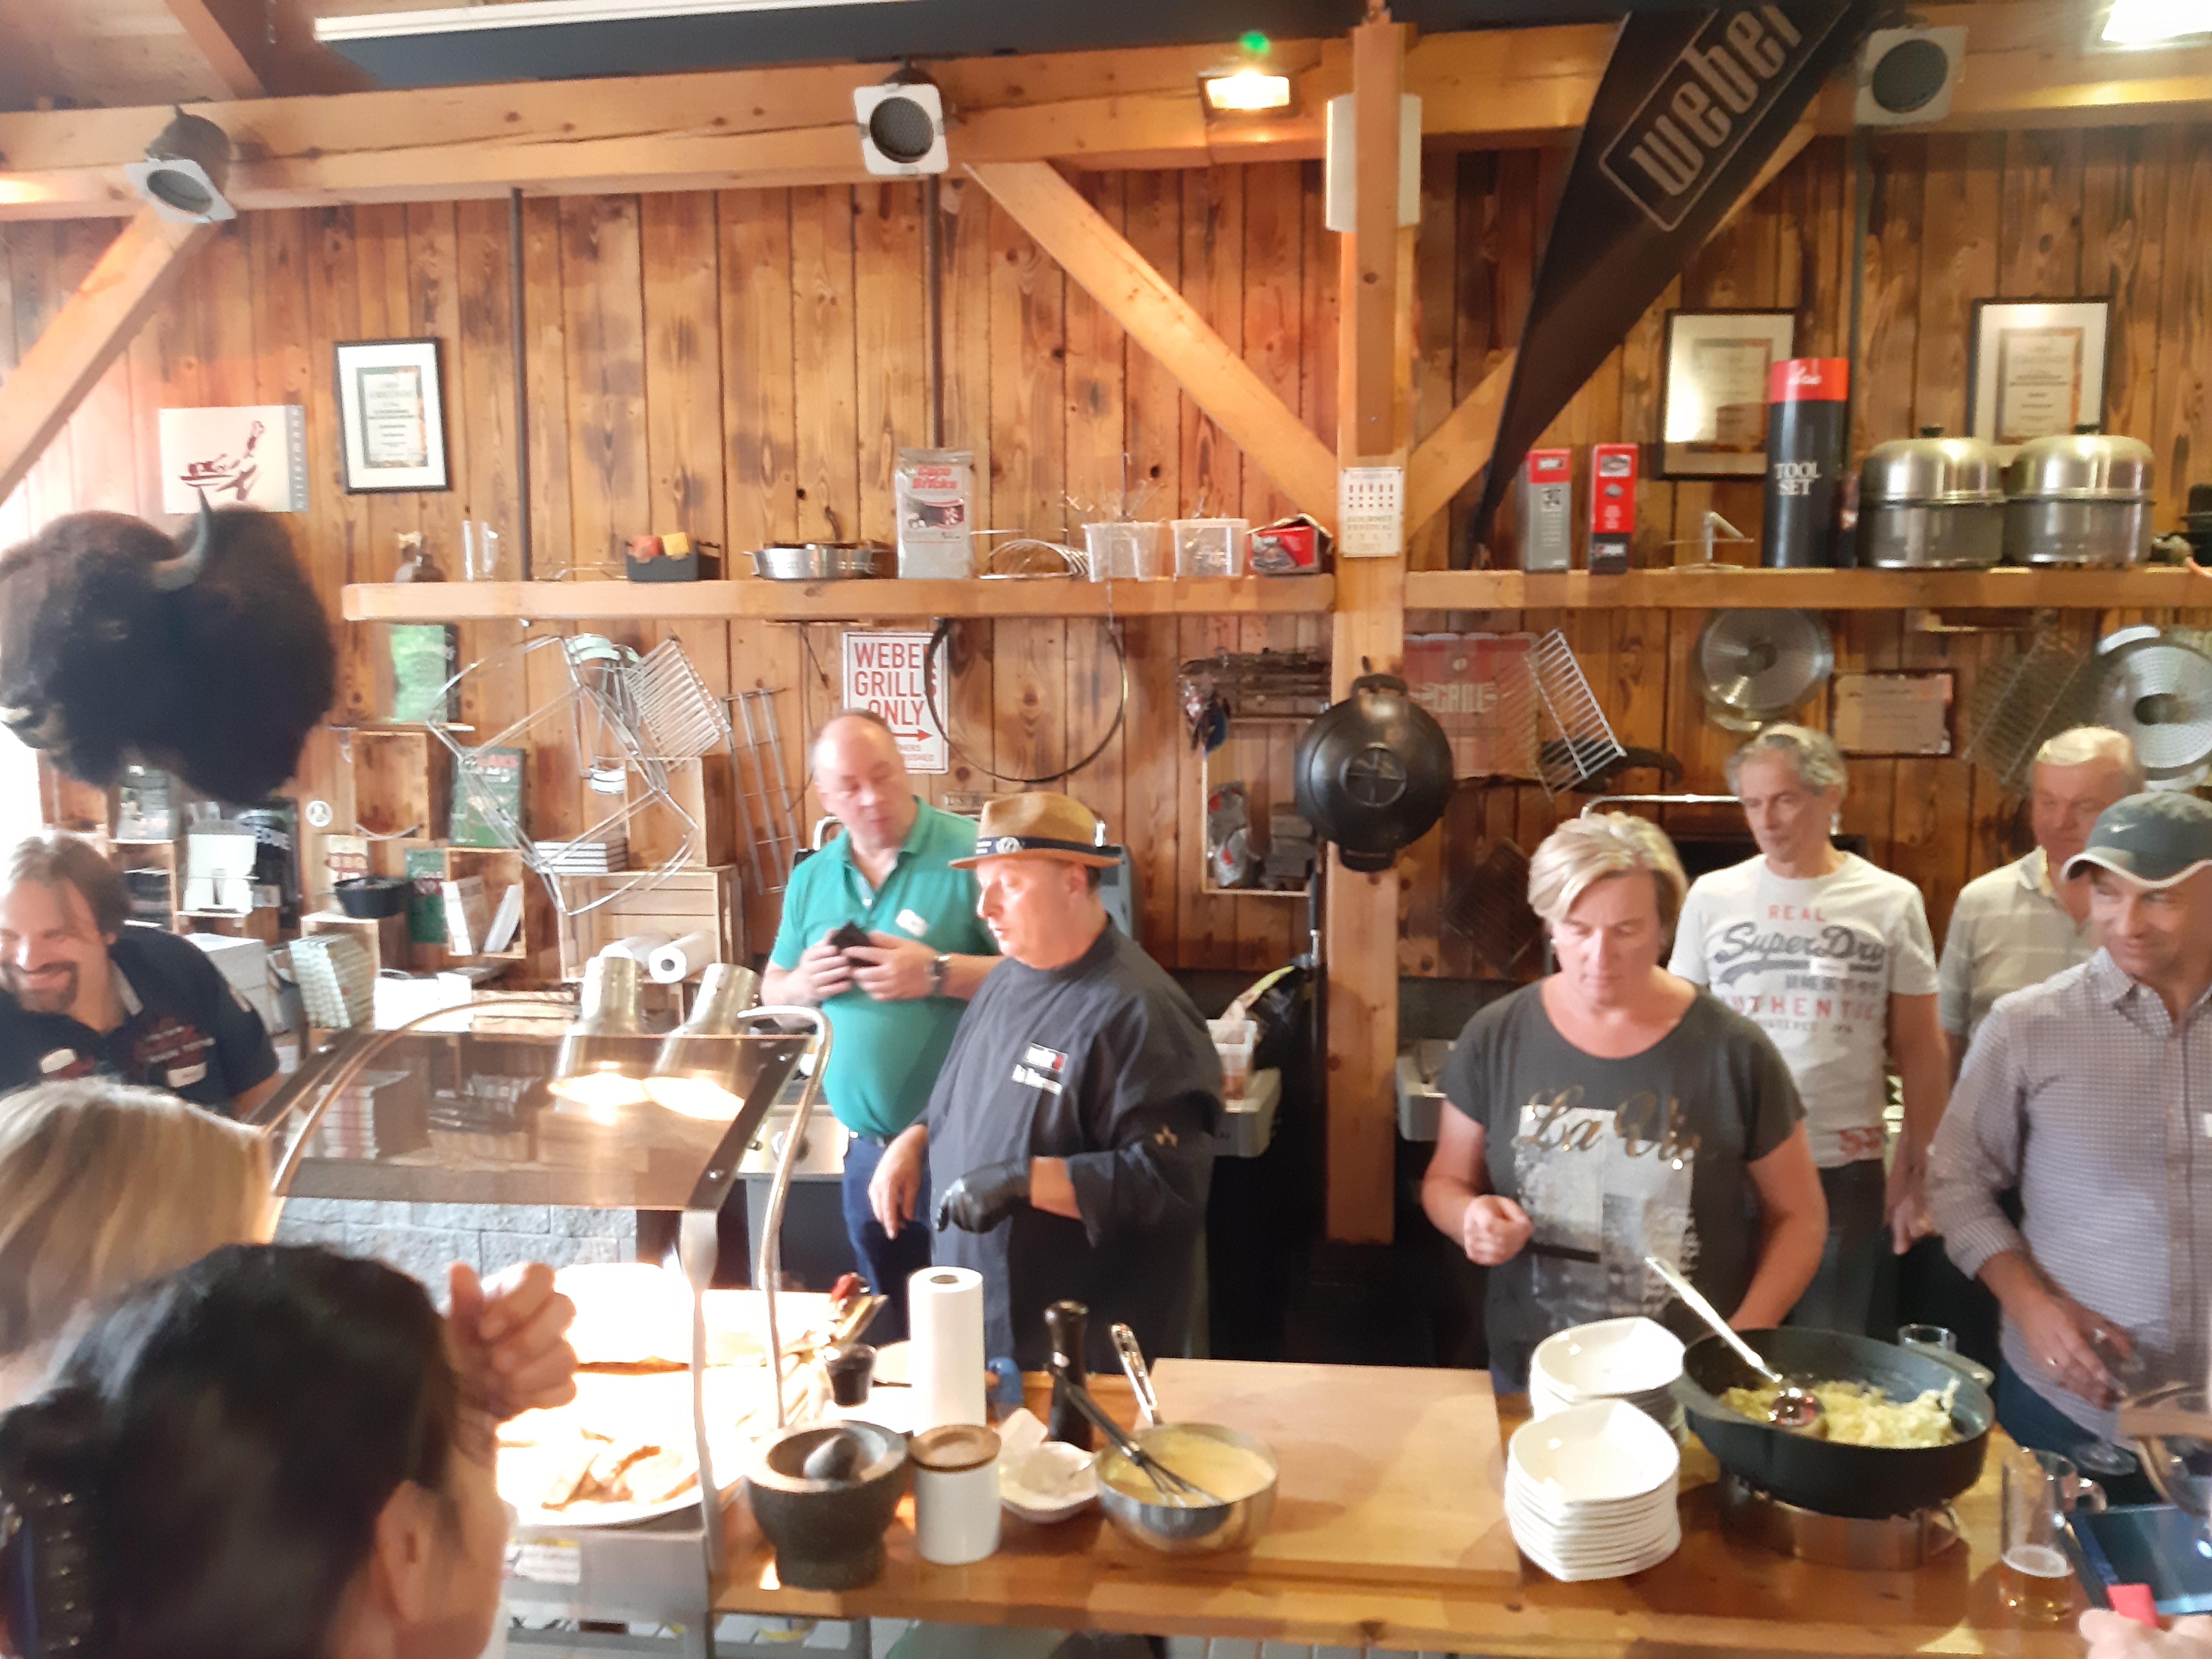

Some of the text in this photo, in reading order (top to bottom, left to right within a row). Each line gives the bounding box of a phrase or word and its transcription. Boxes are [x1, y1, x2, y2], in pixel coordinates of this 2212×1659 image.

[1774, 462, 1821, 479] TOOL
[1778, 479, 1811, 495] SET
[1768, 904, 1826, 923] REAL
[1733, 995, 1878, 1020] UTHENTIC
